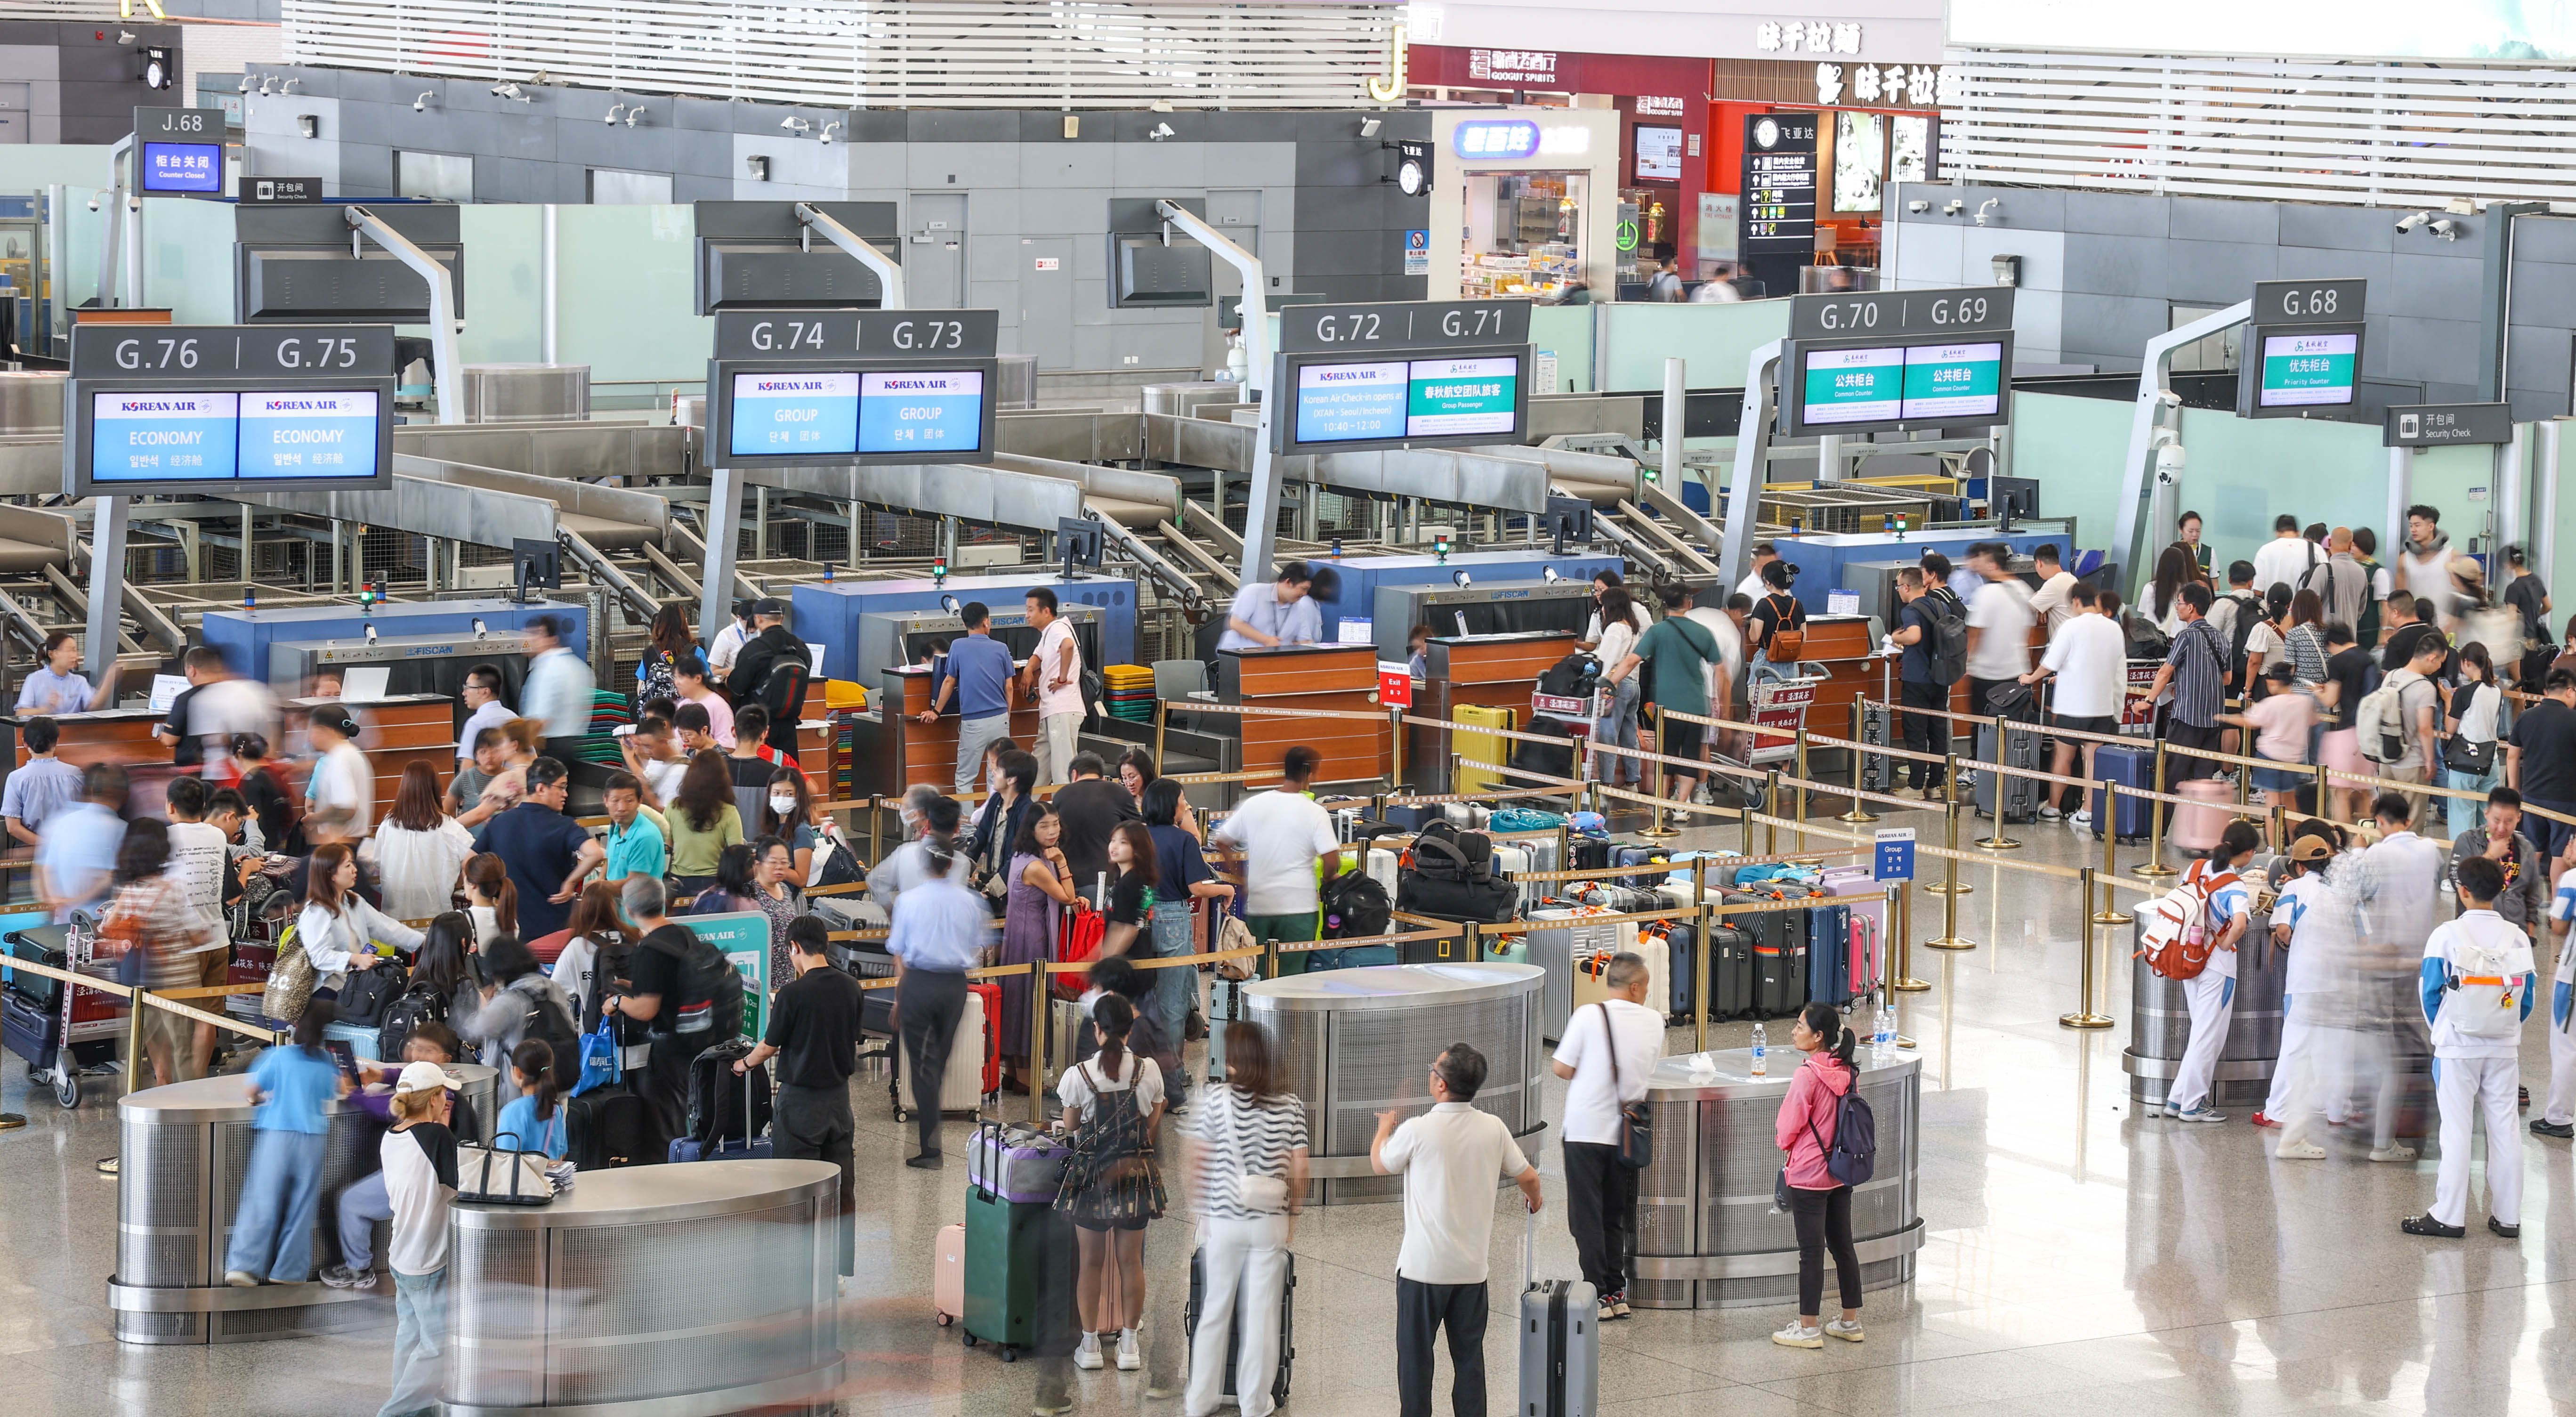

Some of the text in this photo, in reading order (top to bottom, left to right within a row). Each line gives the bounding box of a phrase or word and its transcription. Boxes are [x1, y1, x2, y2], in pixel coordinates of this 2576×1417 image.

[1369, 25, 1404, 101] J
[1492, 72, 1556, 83] GOOGUT SPIRITS
[162, 114, 202, 132] J.68
[1781, 127, 1814, 139] 飞亚达
[1403, 146, 1422, 156] 飞亚达
[156, 154, 209, 168] 柜台关闭
[277, 183, 303, 192] 开包间
[1706, 204, 1732, 212] 消火栓
[2284, 289, 2337, 315] G.68
[1820, 302, 1878, 330] G.70
[1931, 298, 1987, 324] G.69
[1317, 314, 1380, 342] G.72
[1443, 309, 1502, 337] G.71
[751, 322, 824, 350] G.74
[893, 321, 962, 349] G.73
[115, 339, 198, 369] G.76
[277, 339, 356, 369] G.75
[2289, 358, 2330, 372] 优先柜台
[1320, 371, 1376, 381] KOREAN AIR
[1835, 373, 1874, 388] 公共柜台
[1933, 368, 1972, 382] 公共柜台
[758, 381, 823, 391] KOREAN AIR
[884, 380, 946, 390] KOREAN AIR
[1425, 384, 1501, 399] 春秋航空团队旅客
[1304, 392, 1403, 404] Korean Air Check-in opens at
[121, 401, 196, 412] KOREAN AIR
[266, 400, 337, 411] KOREAN AIR
[1442, 401, 1483, 410] Group Passenger
[775, 408, 818, 422] GROUP
[900, 407, 942, 420] GROUP
[2426, 414, 2455, 425] 开包间
[129, 430, 203, 445] ECONOMY
[274, 429, 344, 444] ECONOMY
[769, 431, 790, 443] 단체
[799, 431, 821, 442] 团体
[895, 429, 914, 441] 단체
[924, 429, 945, 440] 团体
[2426, 428, 2471, 439] Security Check
[129, 454, 159, 468] 일반석
[170, 454, 202, 467] 经济舱
[274, 453, 301, 466] 일반석
[312, 453, 343, 465] 经济舱
[1500, 590, 1528, 598] FISCAN
[993, 617, 1024, 625] FISCAN
[416, 646, 452, 655] FISCAN
[1787, 691, 1810, 701] 泾渭茯茶
[1441, 722, 1490, 733] 西安咸阳国际机场
[1777, 719, 1798, 727] 陕西名片
[1712, 857, 1770, 865] 西安咸阳国际机场
[1754, 900, 1816, 910] 西安咸阳国际机场
[1522, 919, 1586, 929] 西安咸阳国际机场
[697, 931, 735, 942] EAN AIR
